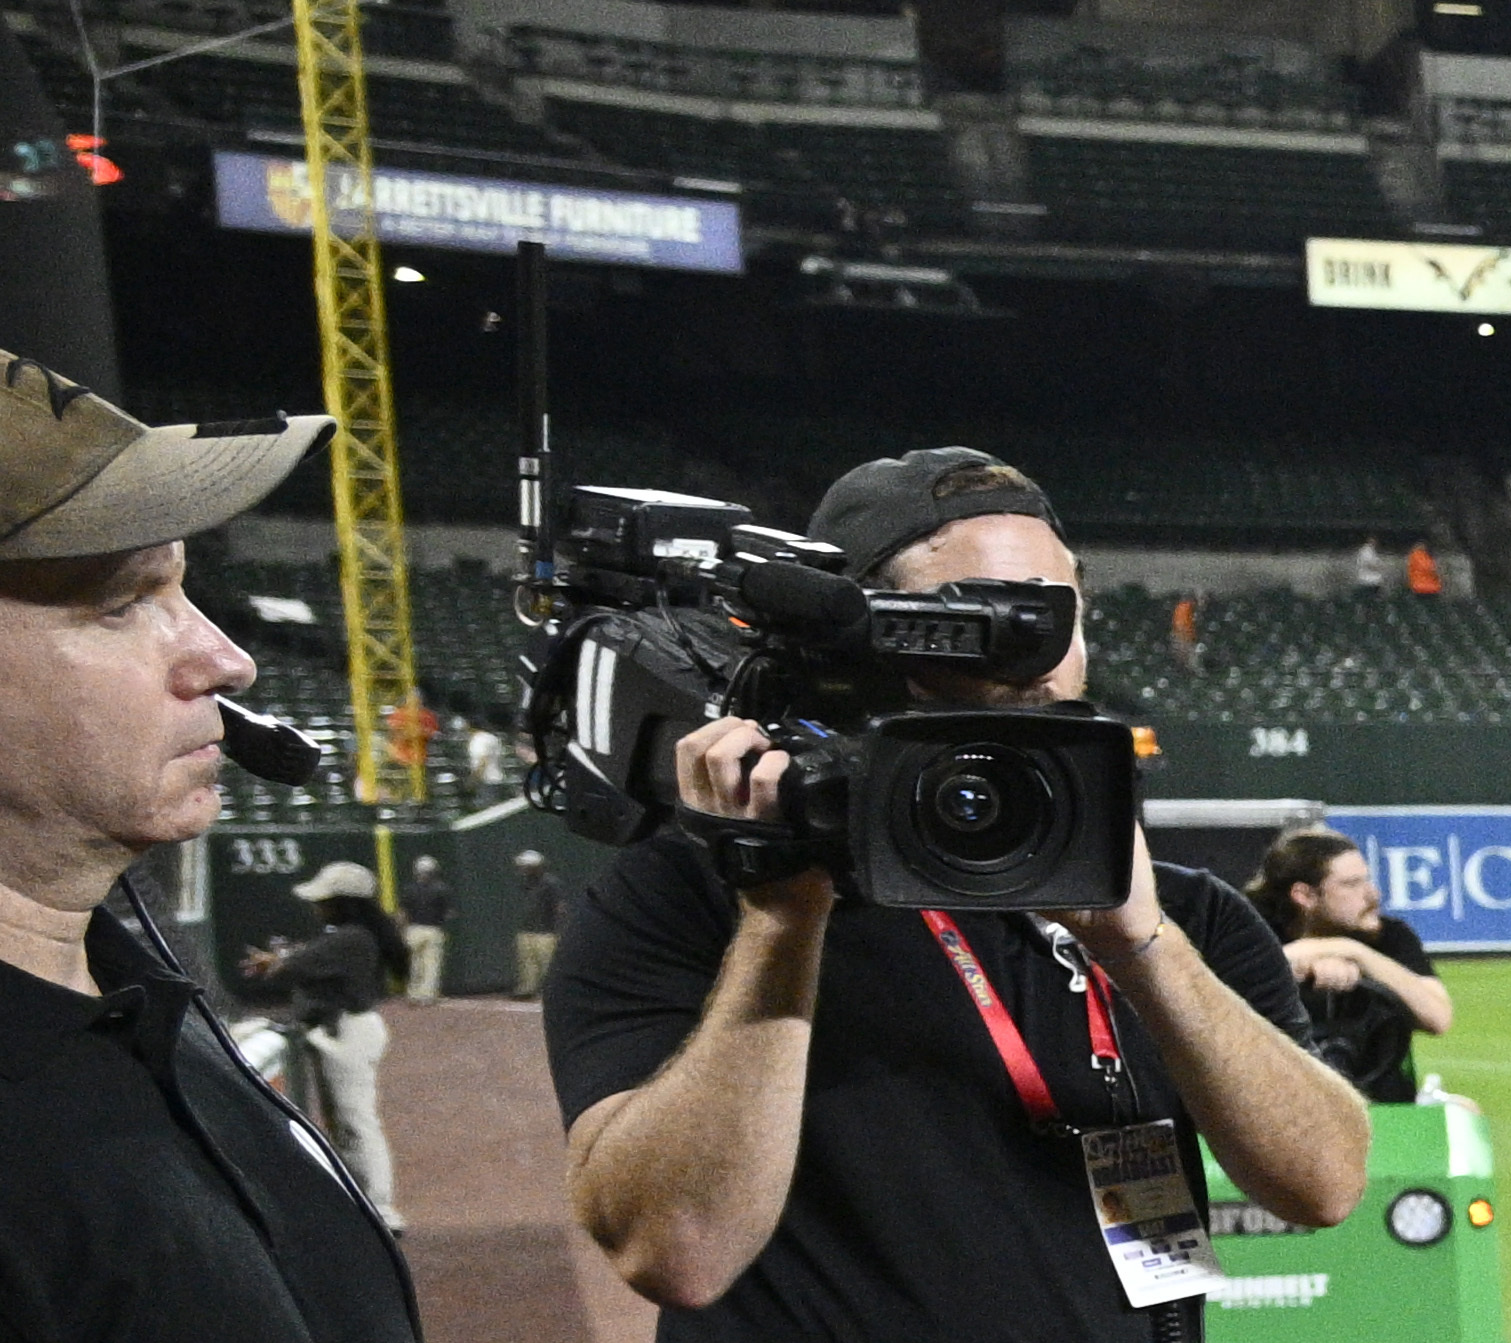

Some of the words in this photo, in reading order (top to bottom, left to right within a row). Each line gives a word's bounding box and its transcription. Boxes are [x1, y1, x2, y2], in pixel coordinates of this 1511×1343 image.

[551, 194, 700, 243] FURNITURE
[1323, 258, 1393, 289] DRINK
[230, 838, 303, 875] 333
